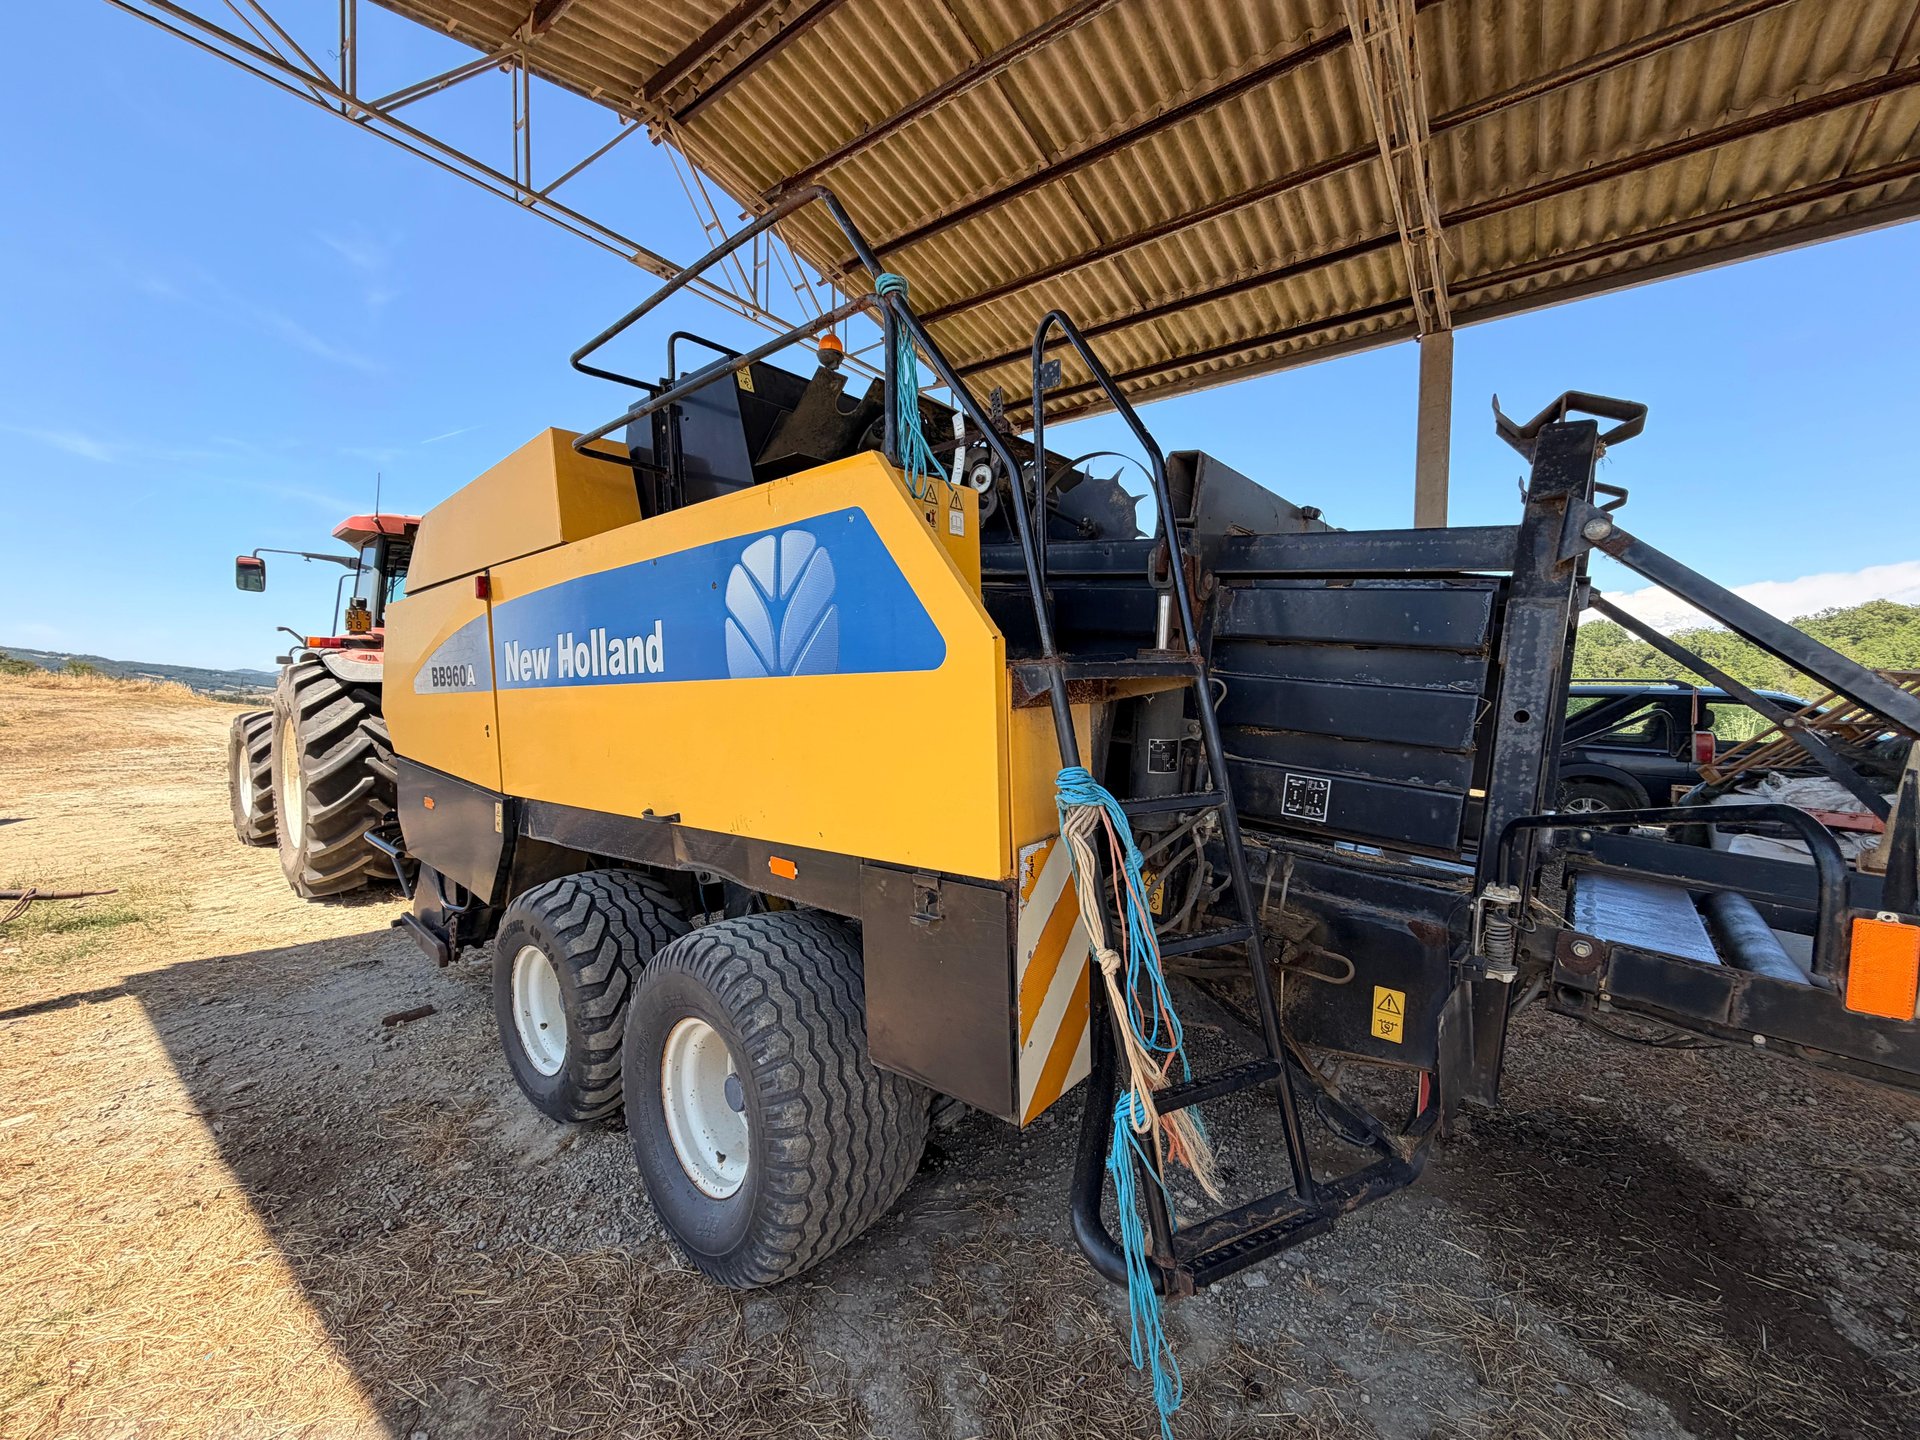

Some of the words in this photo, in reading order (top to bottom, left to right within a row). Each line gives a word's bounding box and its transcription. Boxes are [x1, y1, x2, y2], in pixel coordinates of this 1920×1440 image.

[504, 639, 551, 683] New
[556, 619, 665, 679] Holland
[431, 663, 477, 688] BB960A
